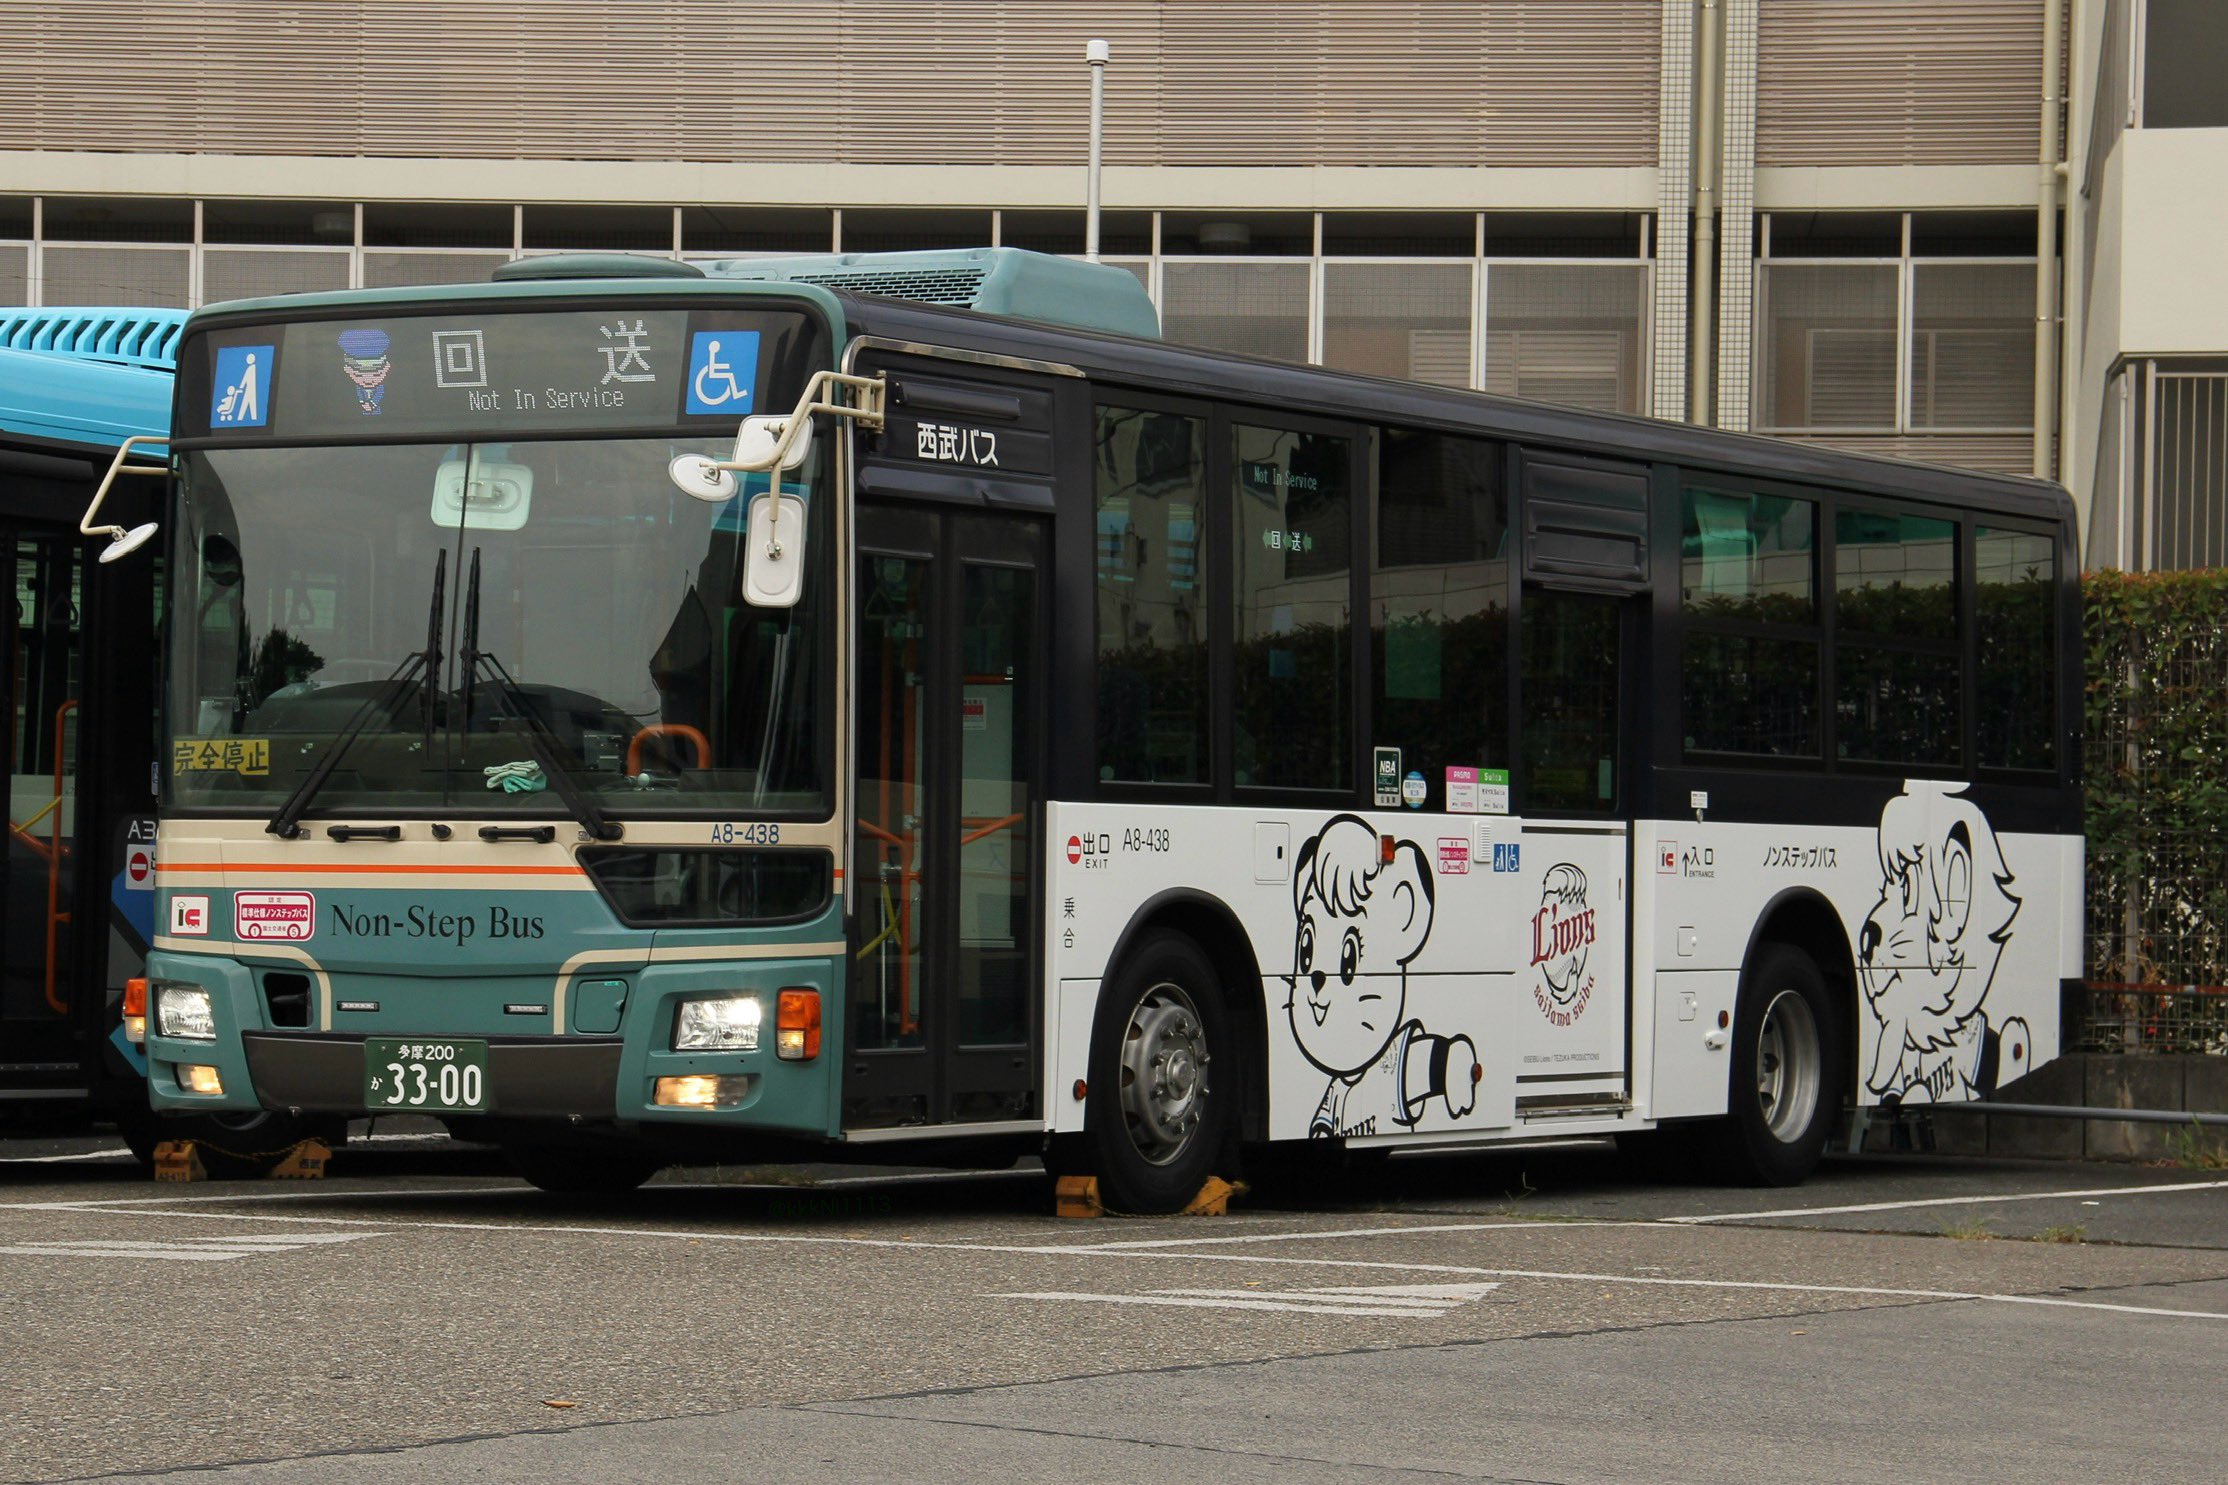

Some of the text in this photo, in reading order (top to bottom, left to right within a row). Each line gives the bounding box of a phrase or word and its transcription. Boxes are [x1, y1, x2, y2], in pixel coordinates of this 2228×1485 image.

[468, 387, 625, 411] Not In Service
[917, 422, 999, 466] 西武バス
[1254, 465, 1317, 491] Not In Service
[175, 742, 268, 774] 完全停止
[1379, 760, 1396, 774] NBA
[711, 823, 780, 844] A8-438
[1083, 832, 1110, 855] 出口
[1122, 828, 1170, 852] A8-438
[1085, 859, 1108, 869] EXIT
[1690, 846, 1714, 866] 入口
[1763, 846, 1837, 868] ノンステップバス
[1688, 870, 1715, 878] ENTRANCE
[242, 907, 308, 918] 標準仕様ノンステップバス
[1063, 897, 1075, 948] 乗合
[331, 904, 544, 947] Non-Step Bus
[1530, 903, 1596, 967] Lions
[370, 1062, 482, 1106] か 33-00
